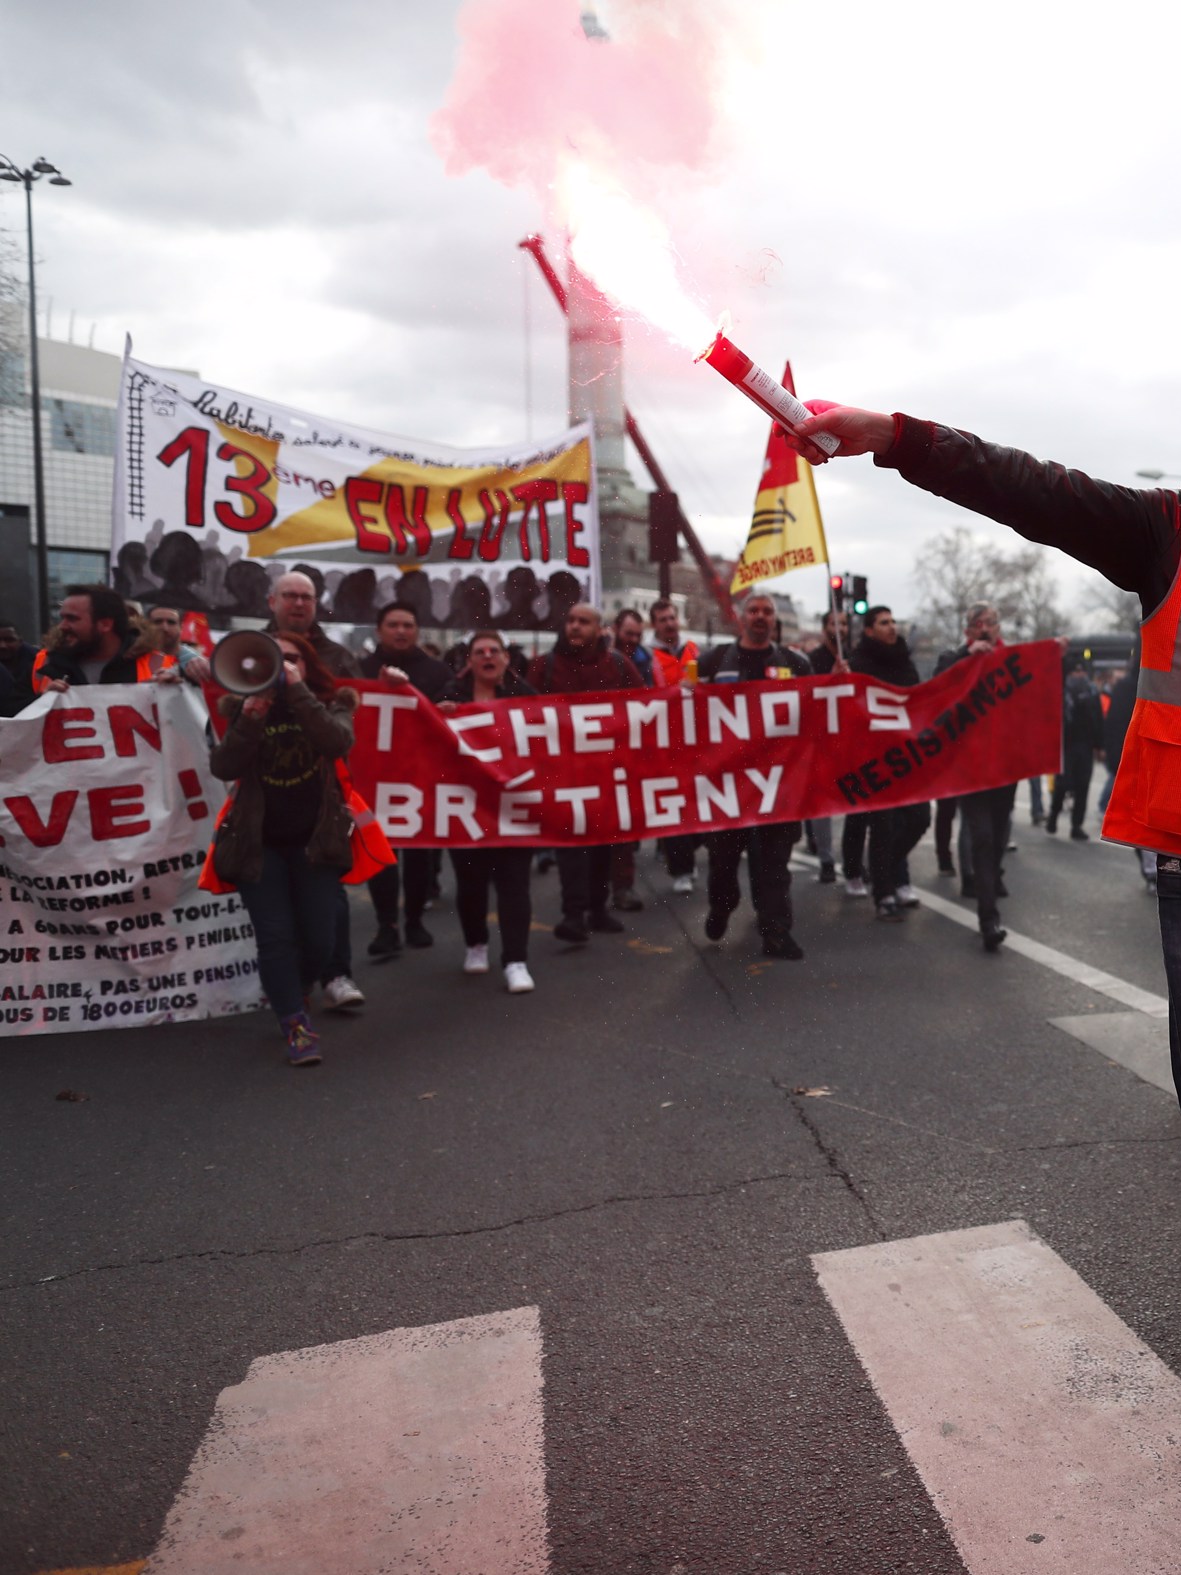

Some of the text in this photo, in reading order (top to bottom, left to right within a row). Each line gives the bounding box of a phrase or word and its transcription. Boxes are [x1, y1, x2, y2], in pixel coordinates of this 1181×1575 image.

[345, 476, 432, 557] EN
[446, 479, 591, 568] LUTTE
[42, 703, 162, 764] EN
[837, 653, 1033, 807] RESISTANCE
[0, 784, 151, 848] VE
[105, 912, 165, 935] POUR
[173, 899, 248, 924] TOUT-E-
[0, 947, 40, 964] OUR
[48, 945, 87, 962] LES
[0, 983, 93, 1003] ALAIRE,
[100, 978, 140, 996] PAS
[148, 972, 187, 992] UNE
[0, 1008, 34, 1024] OUS
[43, 1006, 70, 1022] DE
